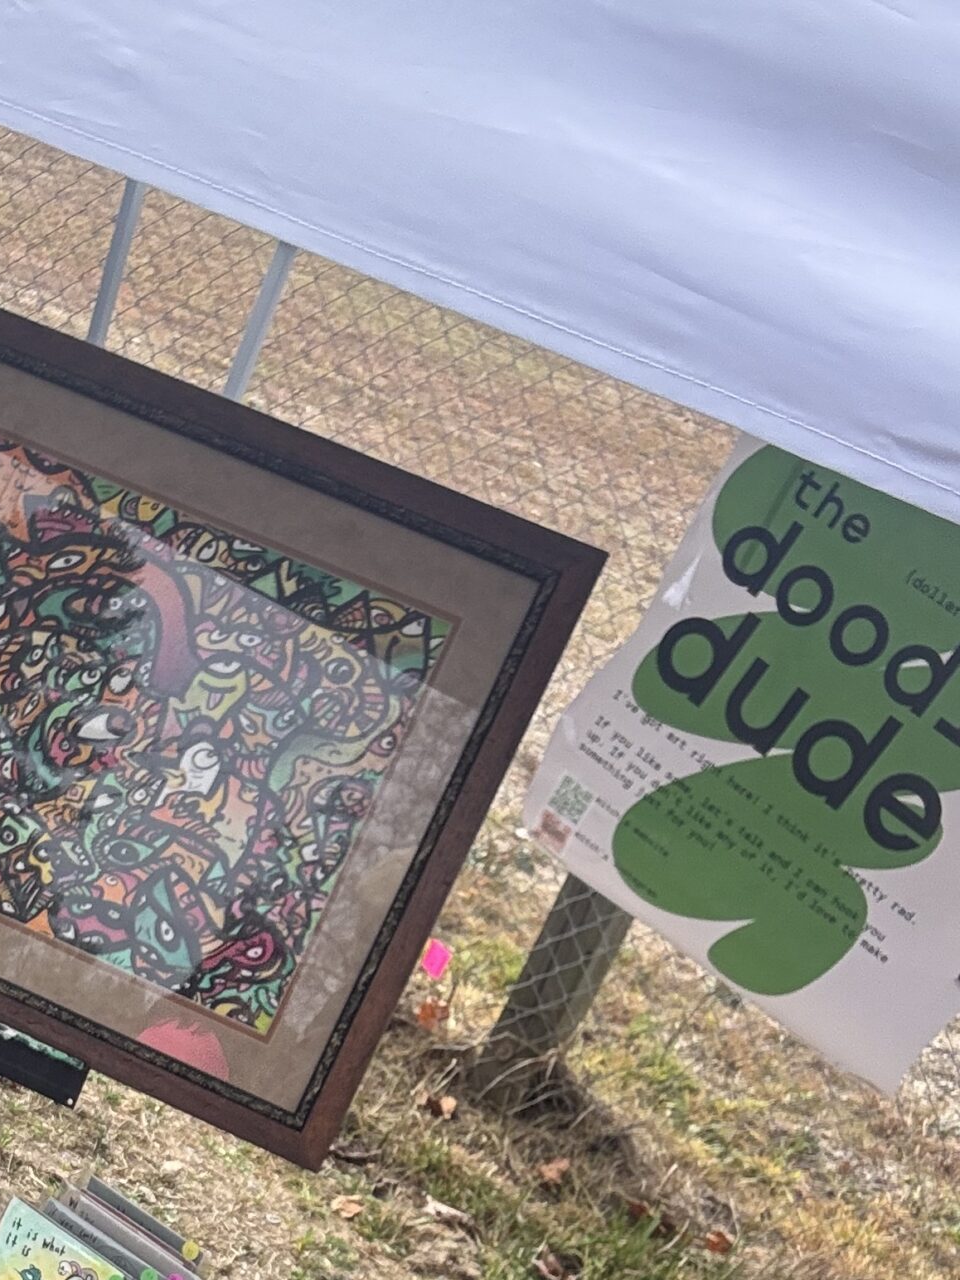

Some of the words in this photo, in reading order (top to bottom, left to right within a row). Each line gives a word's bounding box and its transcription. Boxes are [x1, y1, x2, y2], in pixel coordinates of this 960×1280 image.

[793, 470, 871, 543] the
[656, 612, 943, 852] dude
[722, 520, 960, 748] dood
[579, 743, 634, 790] something
[610, 731, 633, 749] you
[636, 746, 661, 771] like
[861, 925, 886, 942] you
[613, 689, 639, 713] I've
[640, 714, 662, 732] got
[777, 815, 808, 843] think
[813, 842, 842, 868] it's
[845, 865, 887, 903] pretty
[891, 902, 919, 925] rad.
[625, 762, 648, 780] you
[860, 939, 888, 963] make
